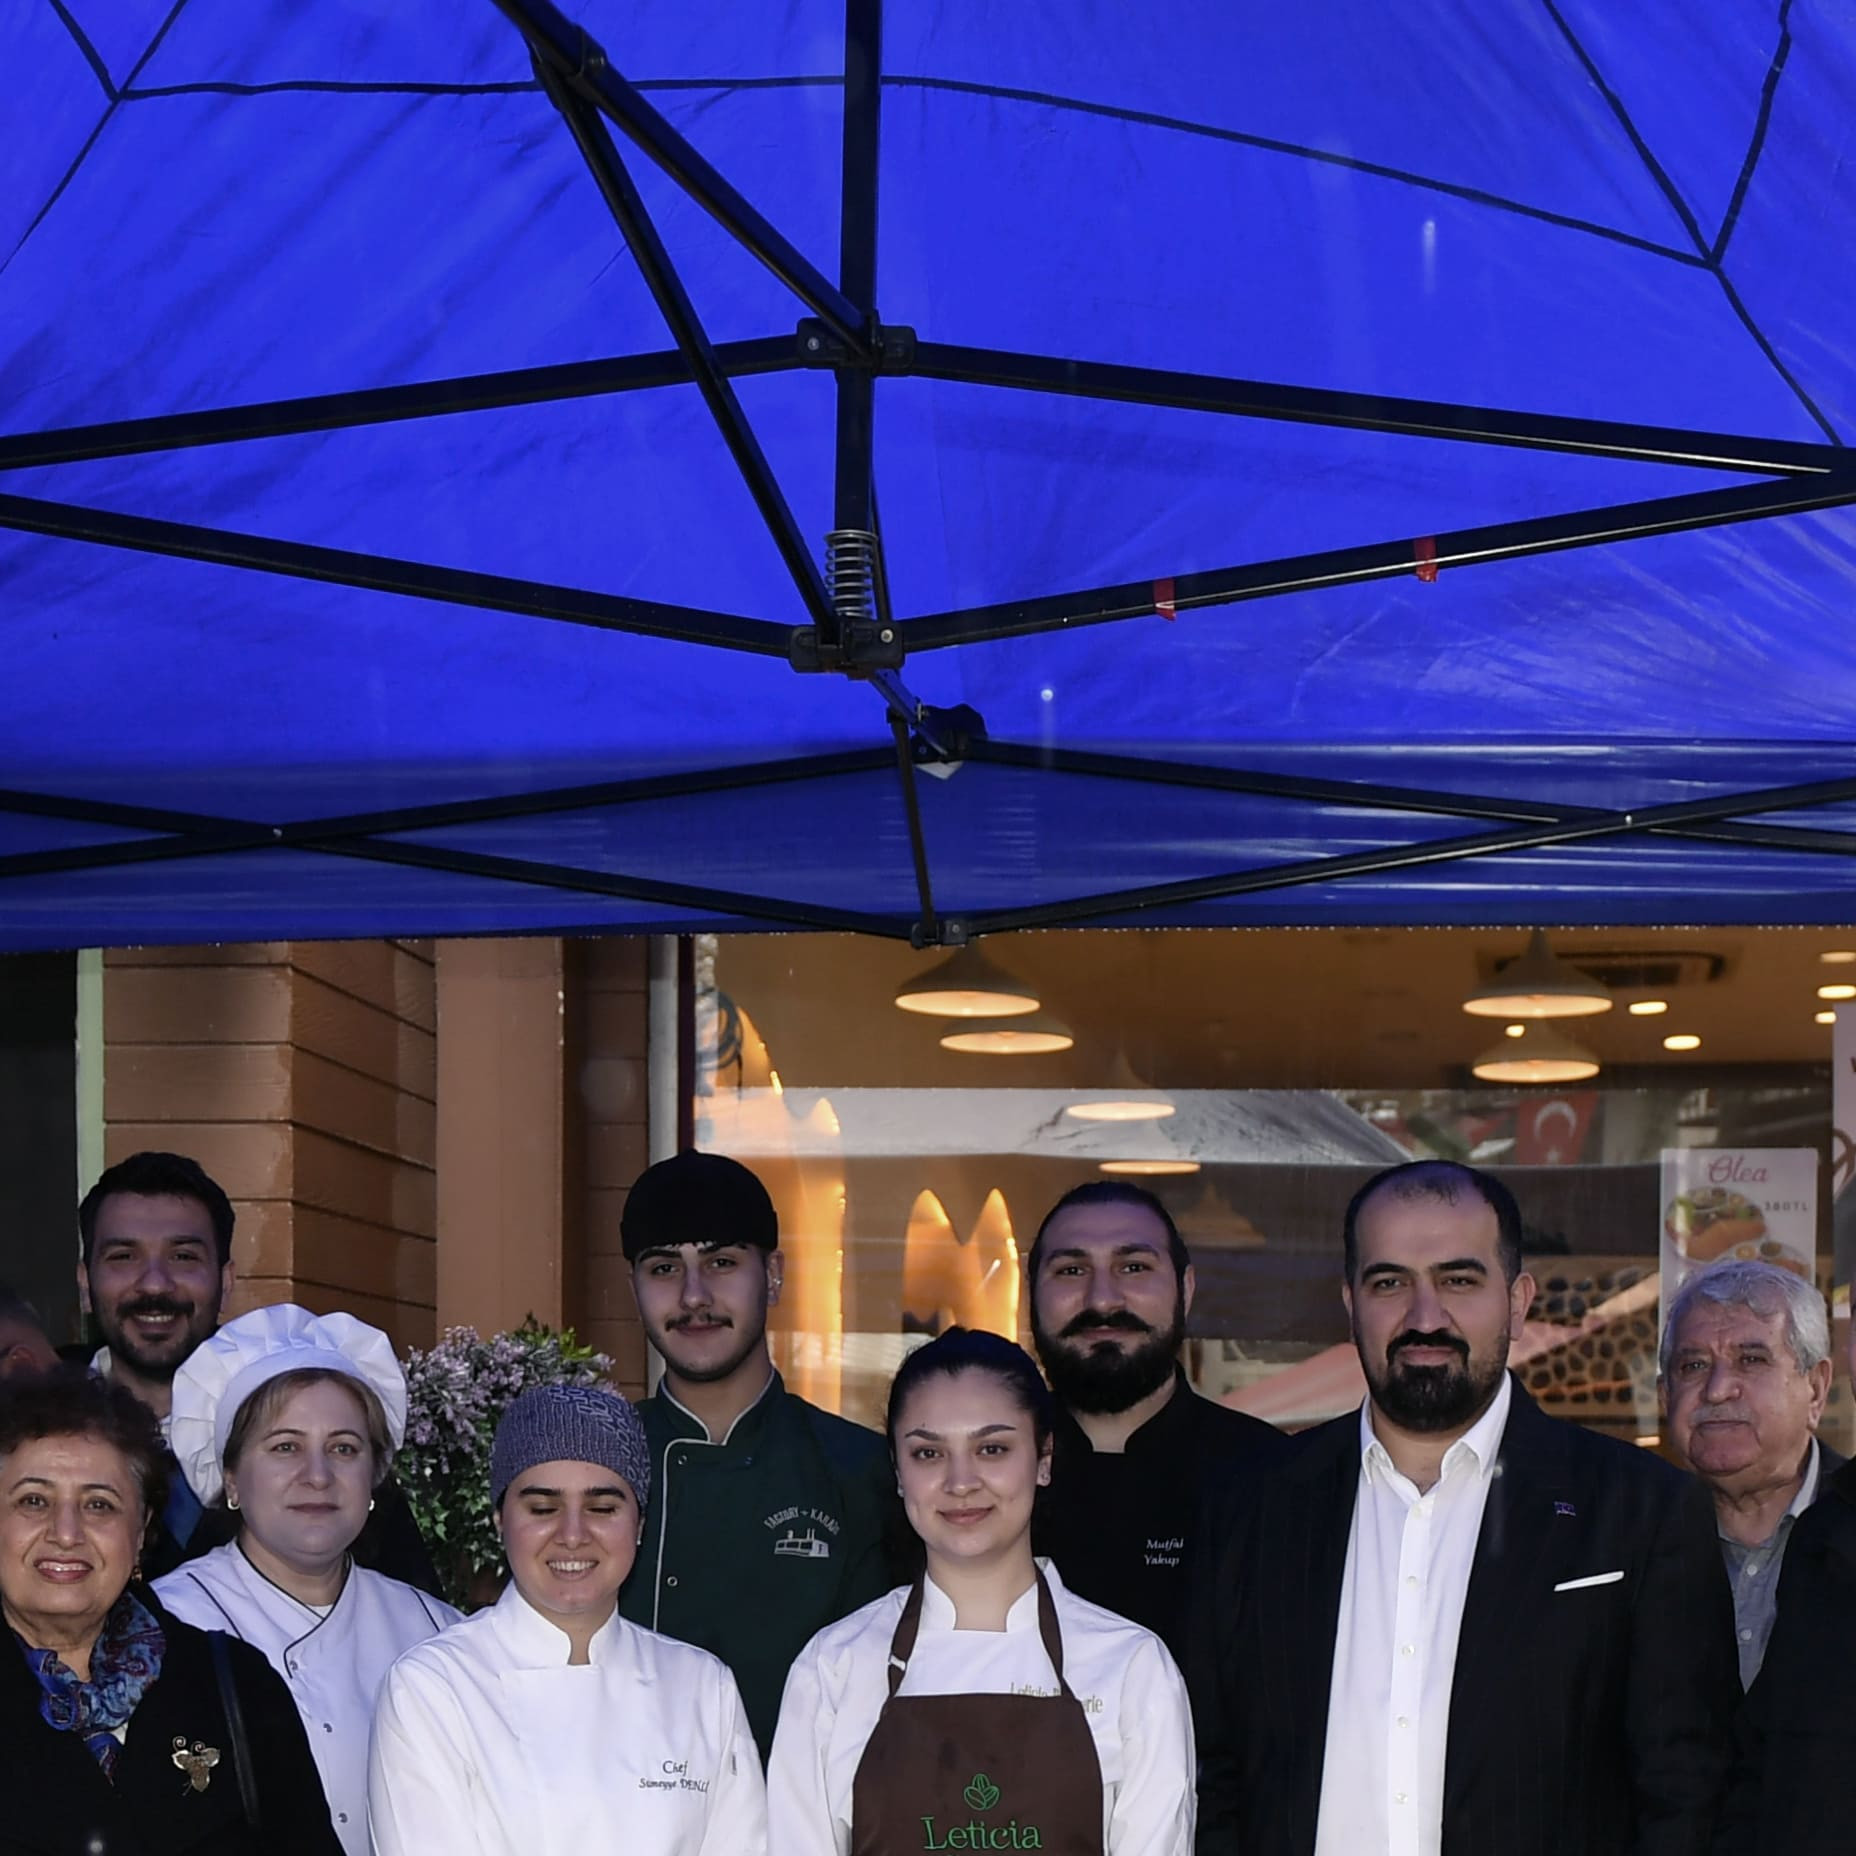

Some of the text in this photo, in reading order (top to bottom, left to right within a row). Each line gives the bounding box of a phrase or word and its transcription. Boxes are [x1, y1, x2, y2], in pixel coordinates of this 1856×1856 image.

[1708, 1154, 1769, 1183] Olea
[662, 1760, 689, 1777] Chef
[920, 1816, 1043, 1850] Leticia
